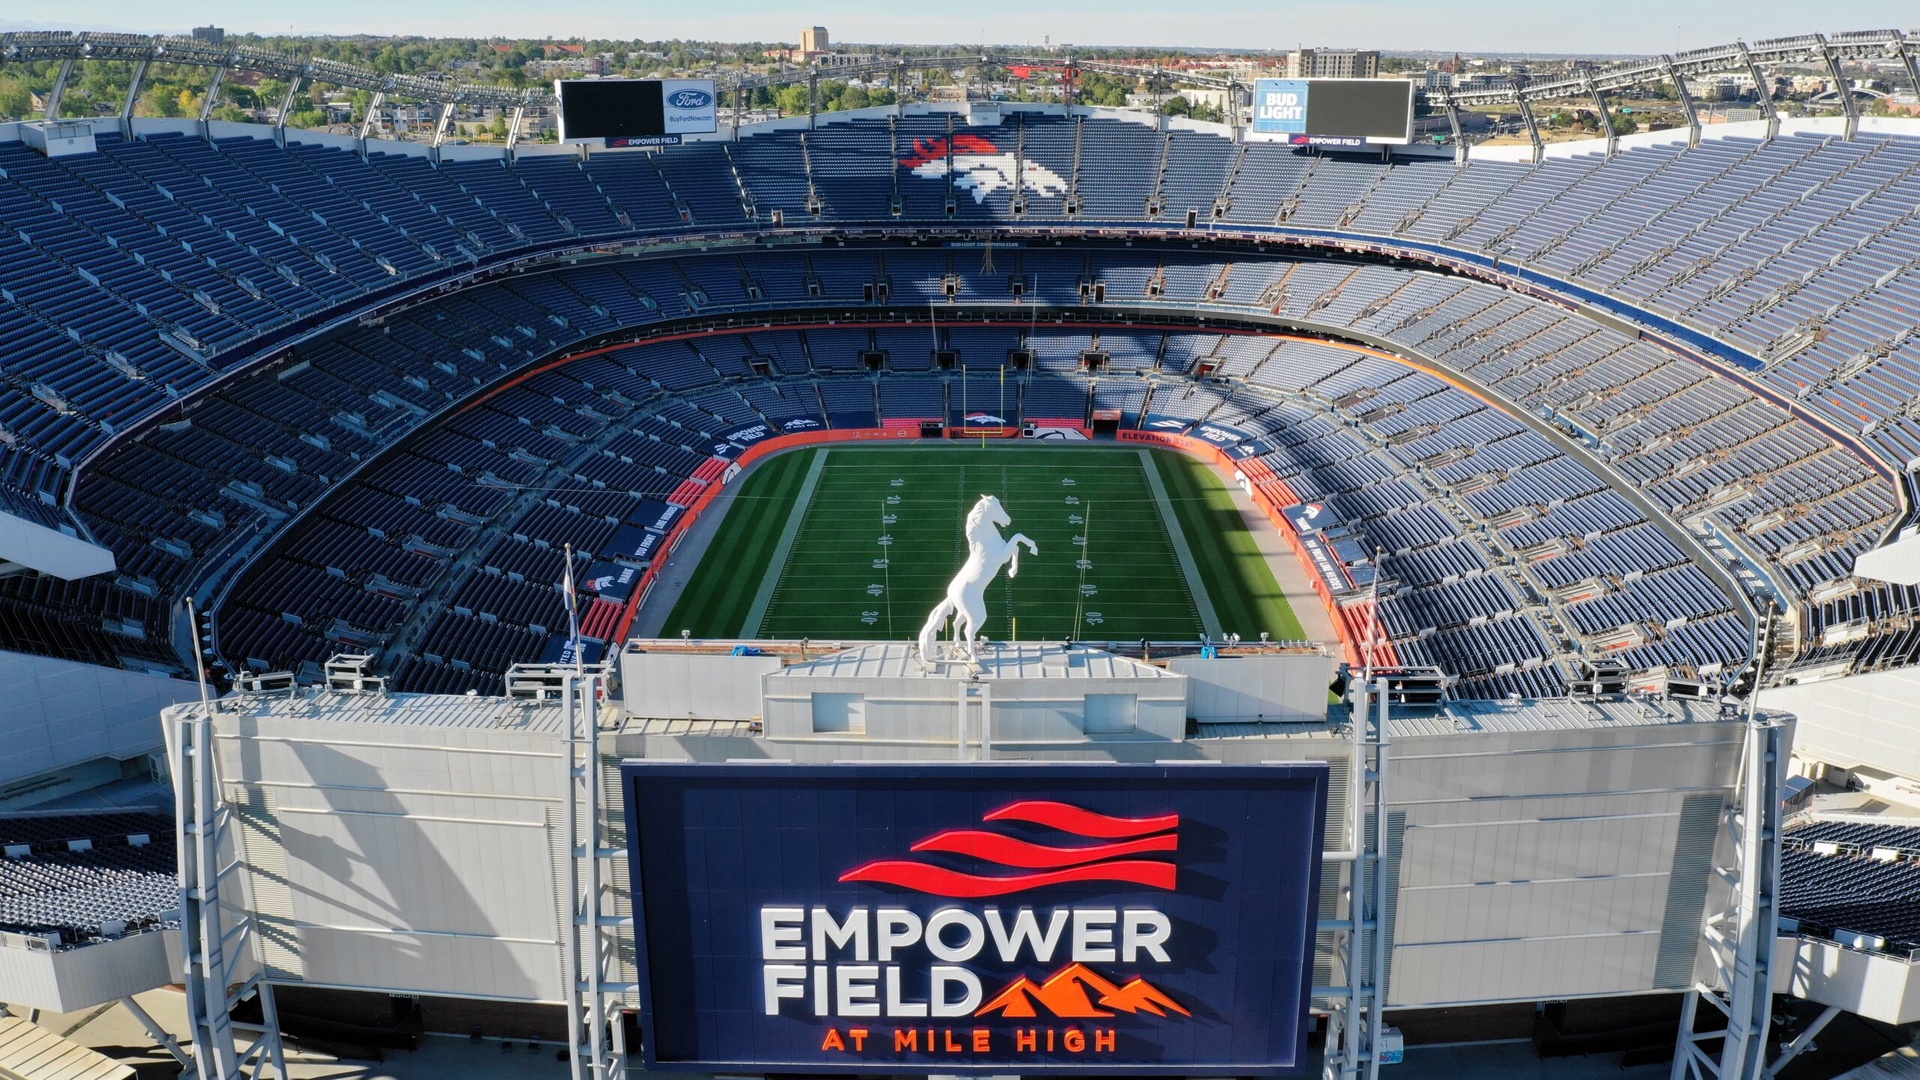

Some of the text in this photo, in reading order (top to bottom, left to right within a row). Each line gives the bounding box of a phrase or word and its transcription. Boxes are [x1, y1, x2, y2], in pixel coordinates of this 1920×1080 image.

[676, 92, 704, 107] Ford
[1266, 93, 1298, 106] BUD
[1260, 106, 1302, 119] LIGHT
[726, 425, 767, 441] EMPOWER
[742, 432, 764, 441] FIELD
[1122, 432, 1172, 443] ELEVATION
[1200, 426, 1241, 441] EMPOWER
[1202, 433, 1226, 442] FIELD
[761, 907, 1172, 962] EMPOWER
[764, 964, 983, 1017] FIELD
[822, 1028, 1116, 1052] AT MILE HIGH
